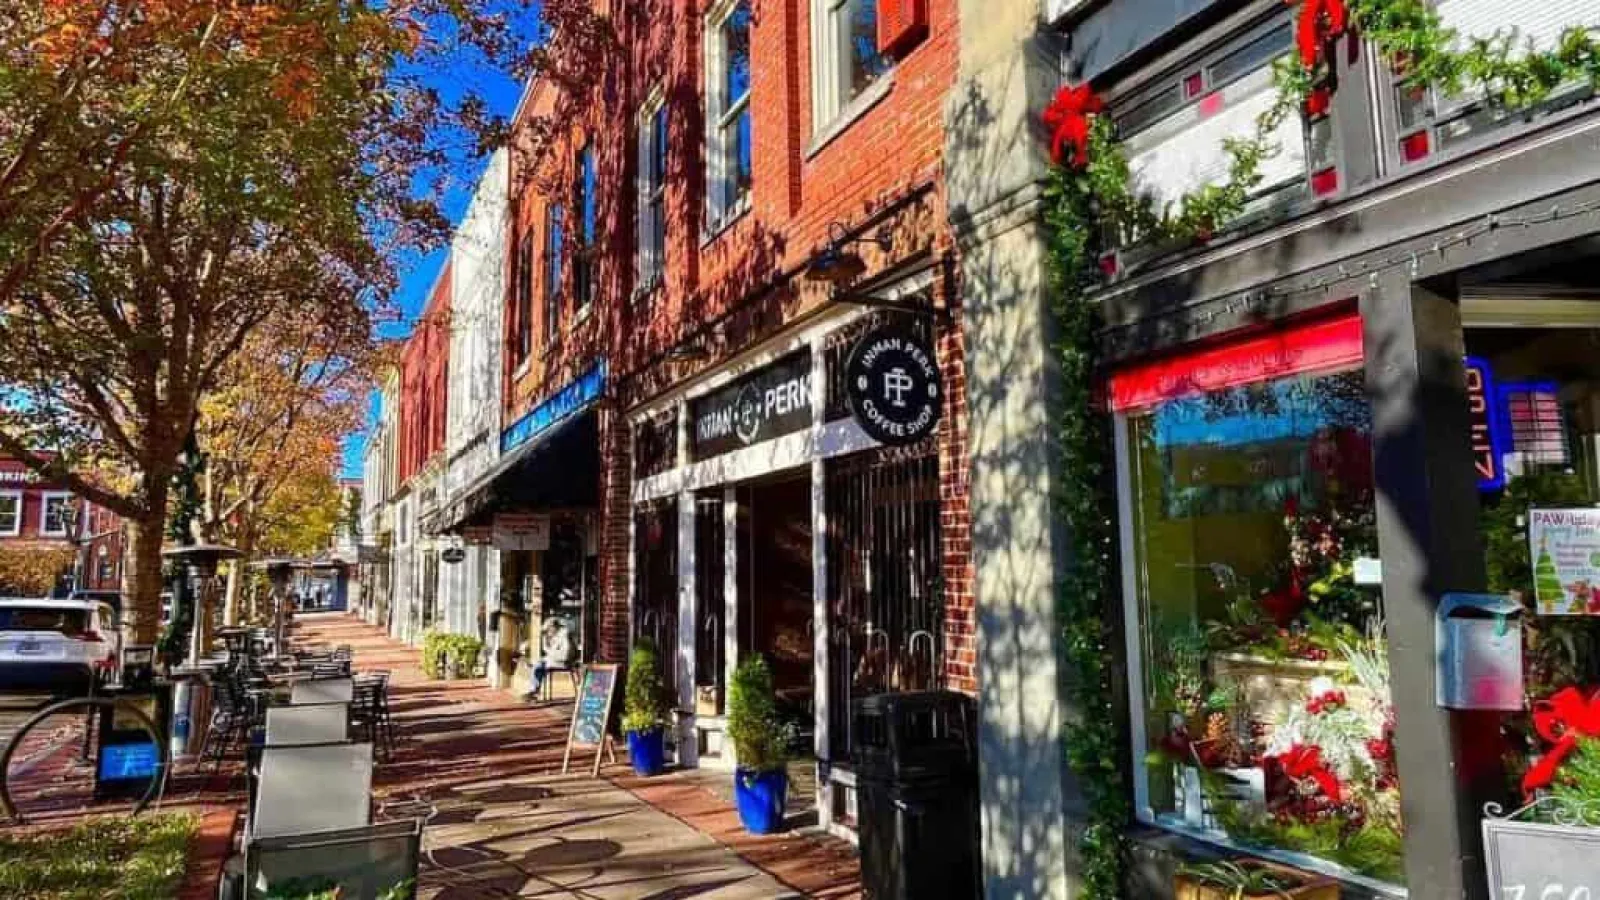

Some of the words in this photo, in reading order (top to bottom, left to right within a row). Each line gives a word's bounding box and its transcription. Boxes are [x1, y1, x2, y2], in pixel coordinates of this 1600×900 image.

[862, 338, 900, 368] INMAN
[905, 342, 934, 378] PERK
[764, 374, 814, 420] PERK
[863, 400, 905, 436] COFFEE
[906, 404, 933, 434] SHOP
